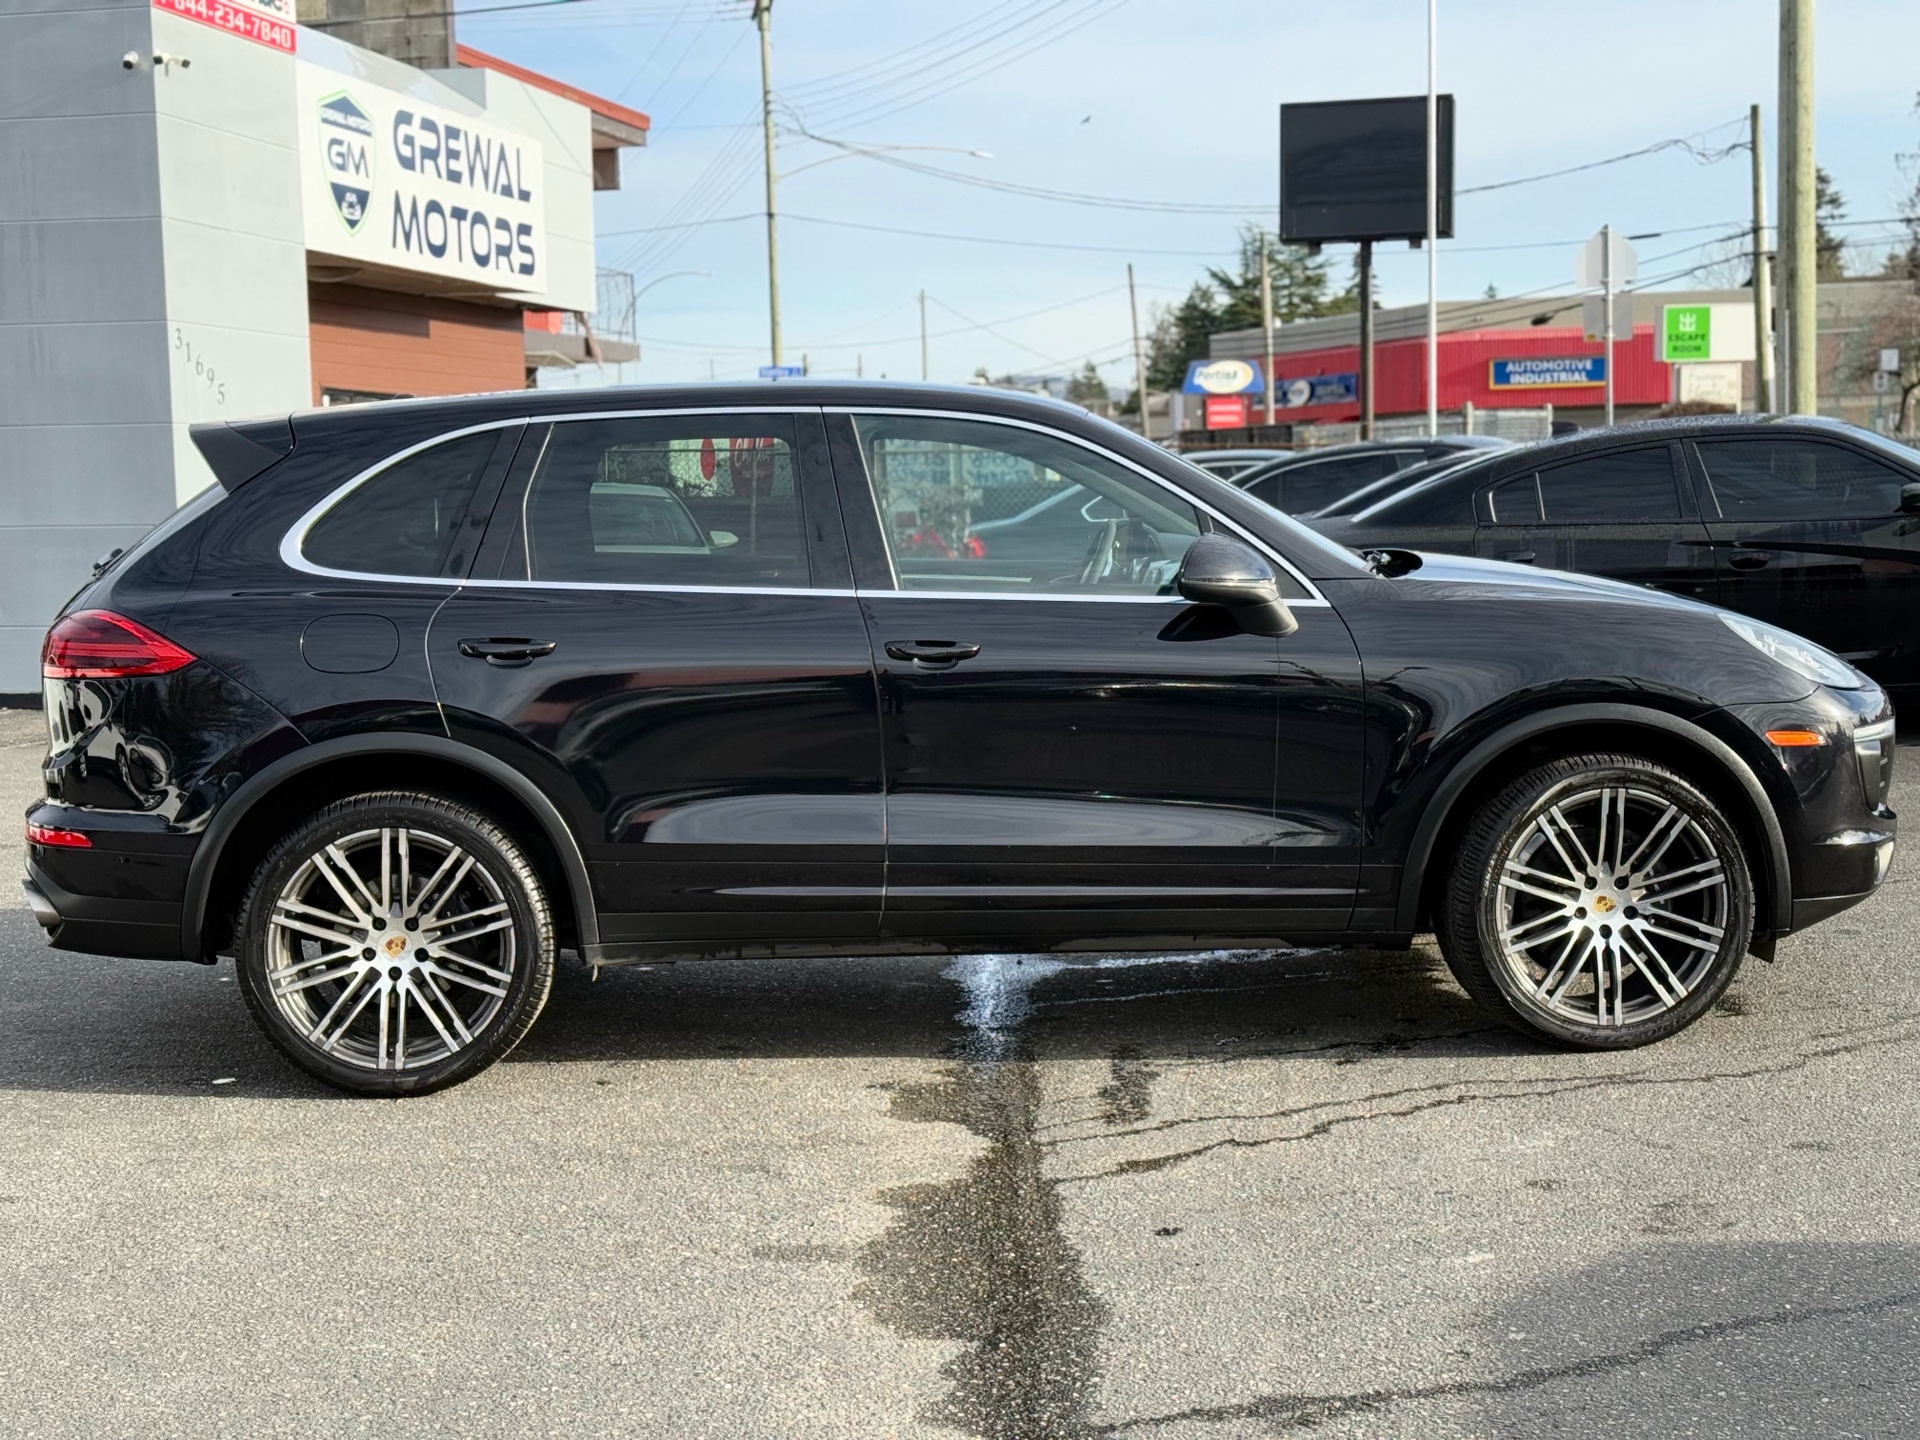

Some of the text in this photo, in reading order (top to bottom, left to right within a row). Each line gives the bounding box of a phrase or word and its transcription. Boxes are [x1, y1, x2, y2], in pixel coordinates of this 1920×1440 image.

[327, 137, 370, 179] GM
[393, 109, 531, 203] GREWAL
[392, 189, 535, 276] MOTORS
[1668, 333, 1706, 342] ESCAPE
[1672, 345, 1702, 353] ROOM
[174, 327, 225, 405] 31695
[1505, 359, 1593, 373] AUTOMOTIVE
[1509, 371, 1589, 384] INDUSTRIAL
